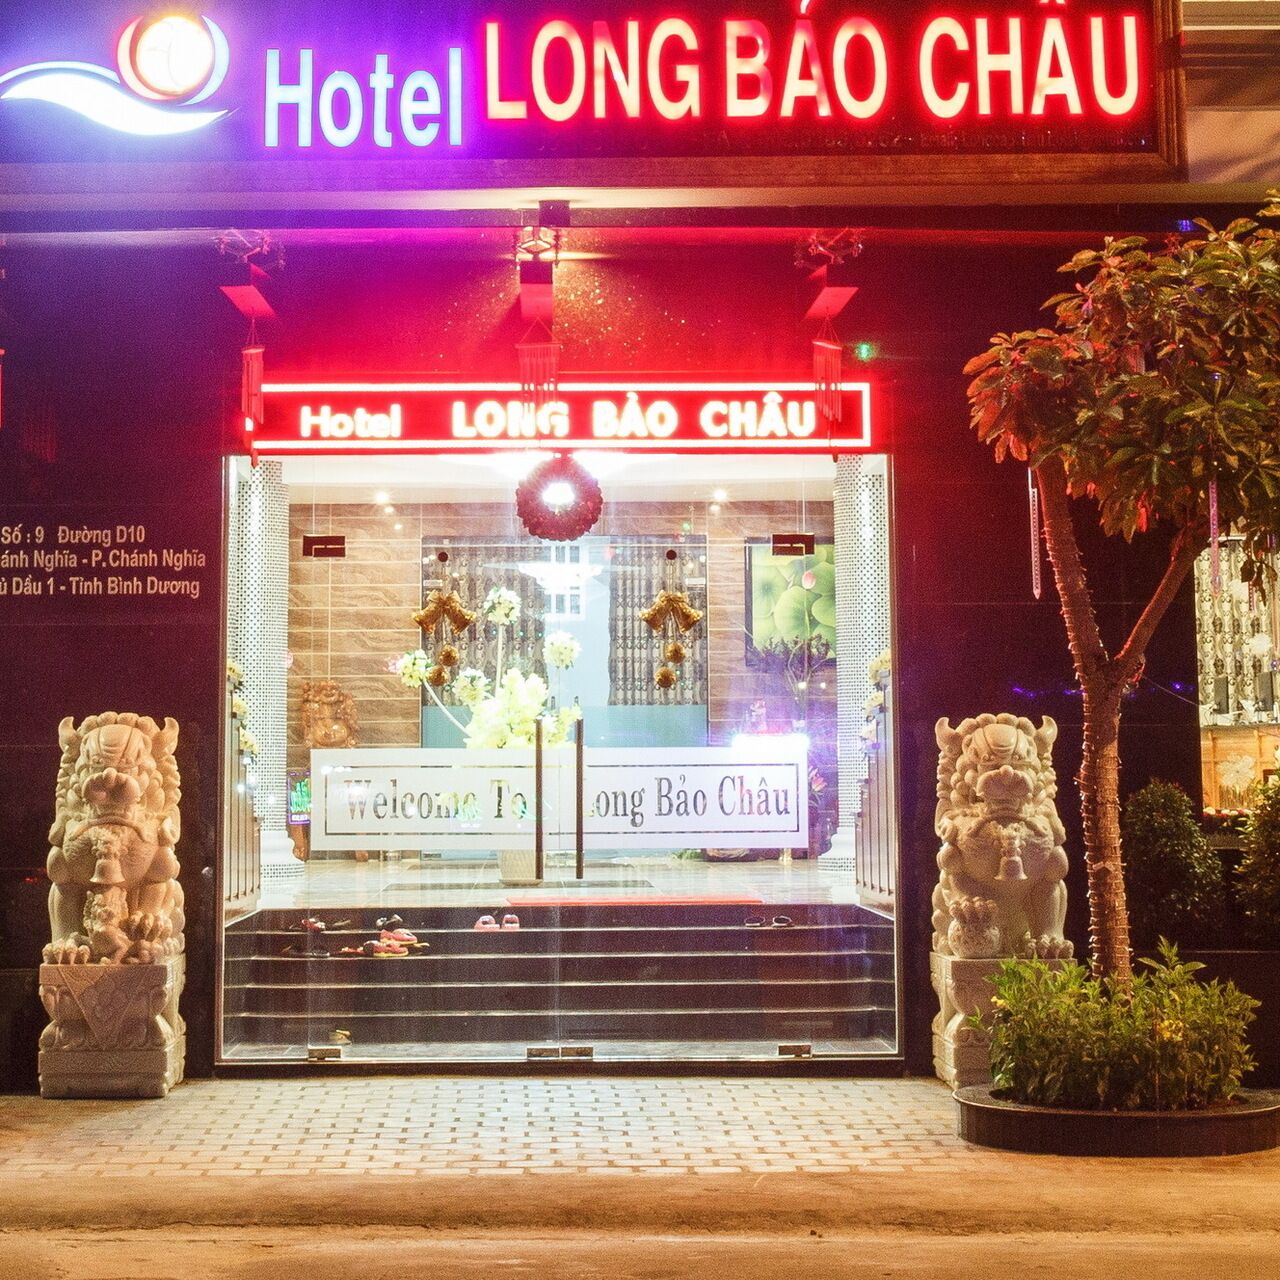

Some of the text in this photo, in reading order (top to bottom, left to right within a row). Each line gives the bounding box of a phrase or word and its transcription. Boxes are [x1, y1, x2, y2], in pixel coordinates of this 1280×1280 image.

[263, 47, 463, 148] Hotel
[485, 18, 701, 121] LONG
[300, 391, 816, 438] Hotel LONG BẢO CHÂU
[1, 524, 24, 544] Số
[35, 526, 45, 543] 9
[57, 525, 111, 547] Đường
[116, 525, 145, 543] D10
[33, 550, 78, 571] Nghĩa
[162, 549, 206, 571] Nghĩa
[12, 574, 42, 595] Dầu
[46, 578, 55, 595] 1
[68, 576, 103, 594] Tỉnh
[107, 576, 142, 594] Bình
[147, 576, 200, 599] Dương
[344, 778, 478, 820] Welcome
[489, 778, 529, 820] To
[588, 786, 645, 827] ong
[654, 774, 708, 817] Bảo
[719, 775, 791, 817] Châu
